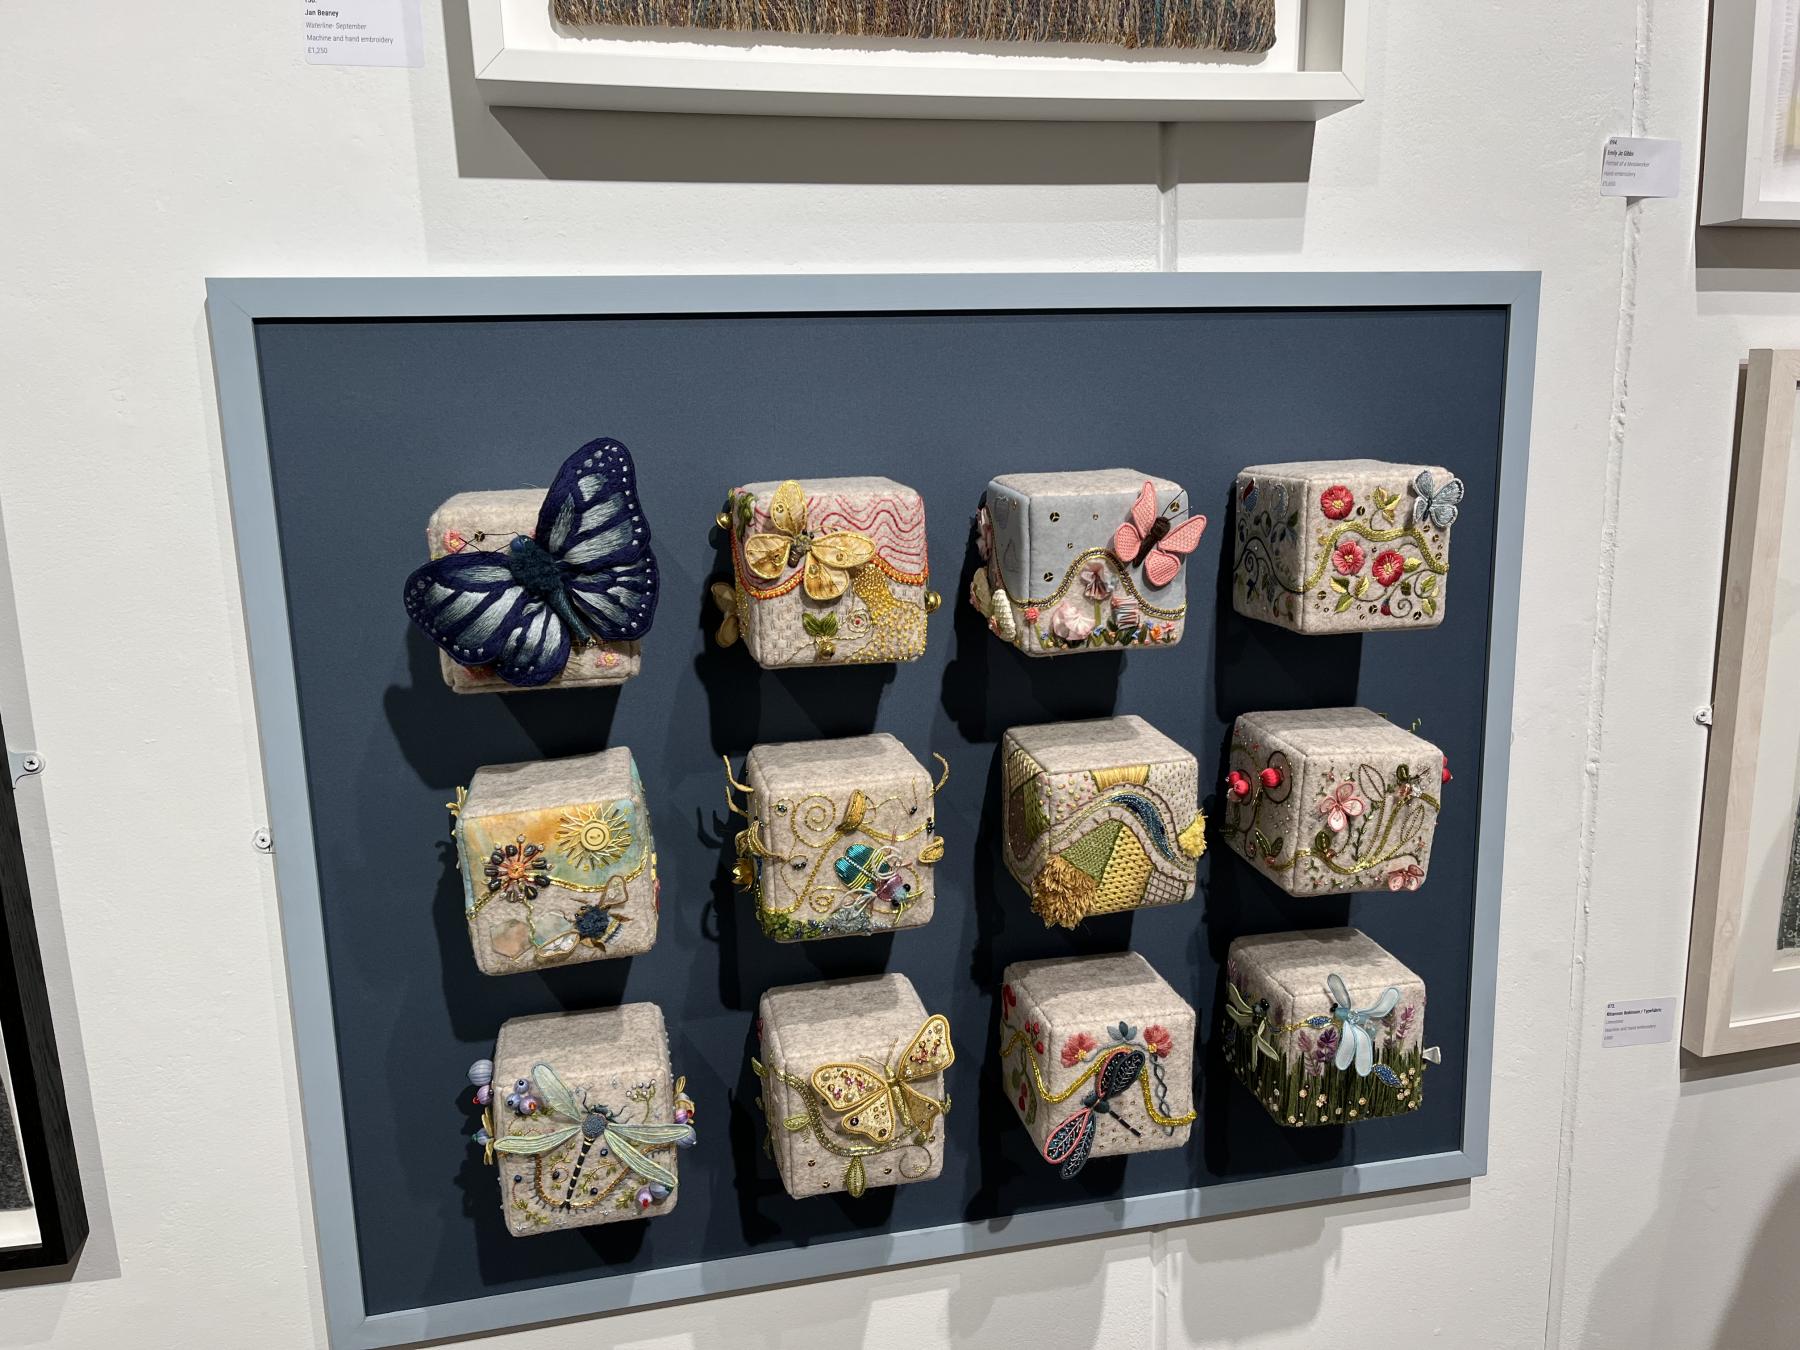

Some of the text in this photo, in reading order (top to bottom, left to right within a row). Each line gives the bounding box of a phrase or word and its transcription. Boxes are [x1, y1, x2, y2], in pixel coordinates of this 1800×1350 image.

[317, 9, 339, 18] Beaney
[335, 22, 367, 31] September
[306, 34, 332, 42] Machine
[360, 36, 394, 45] embroidery
